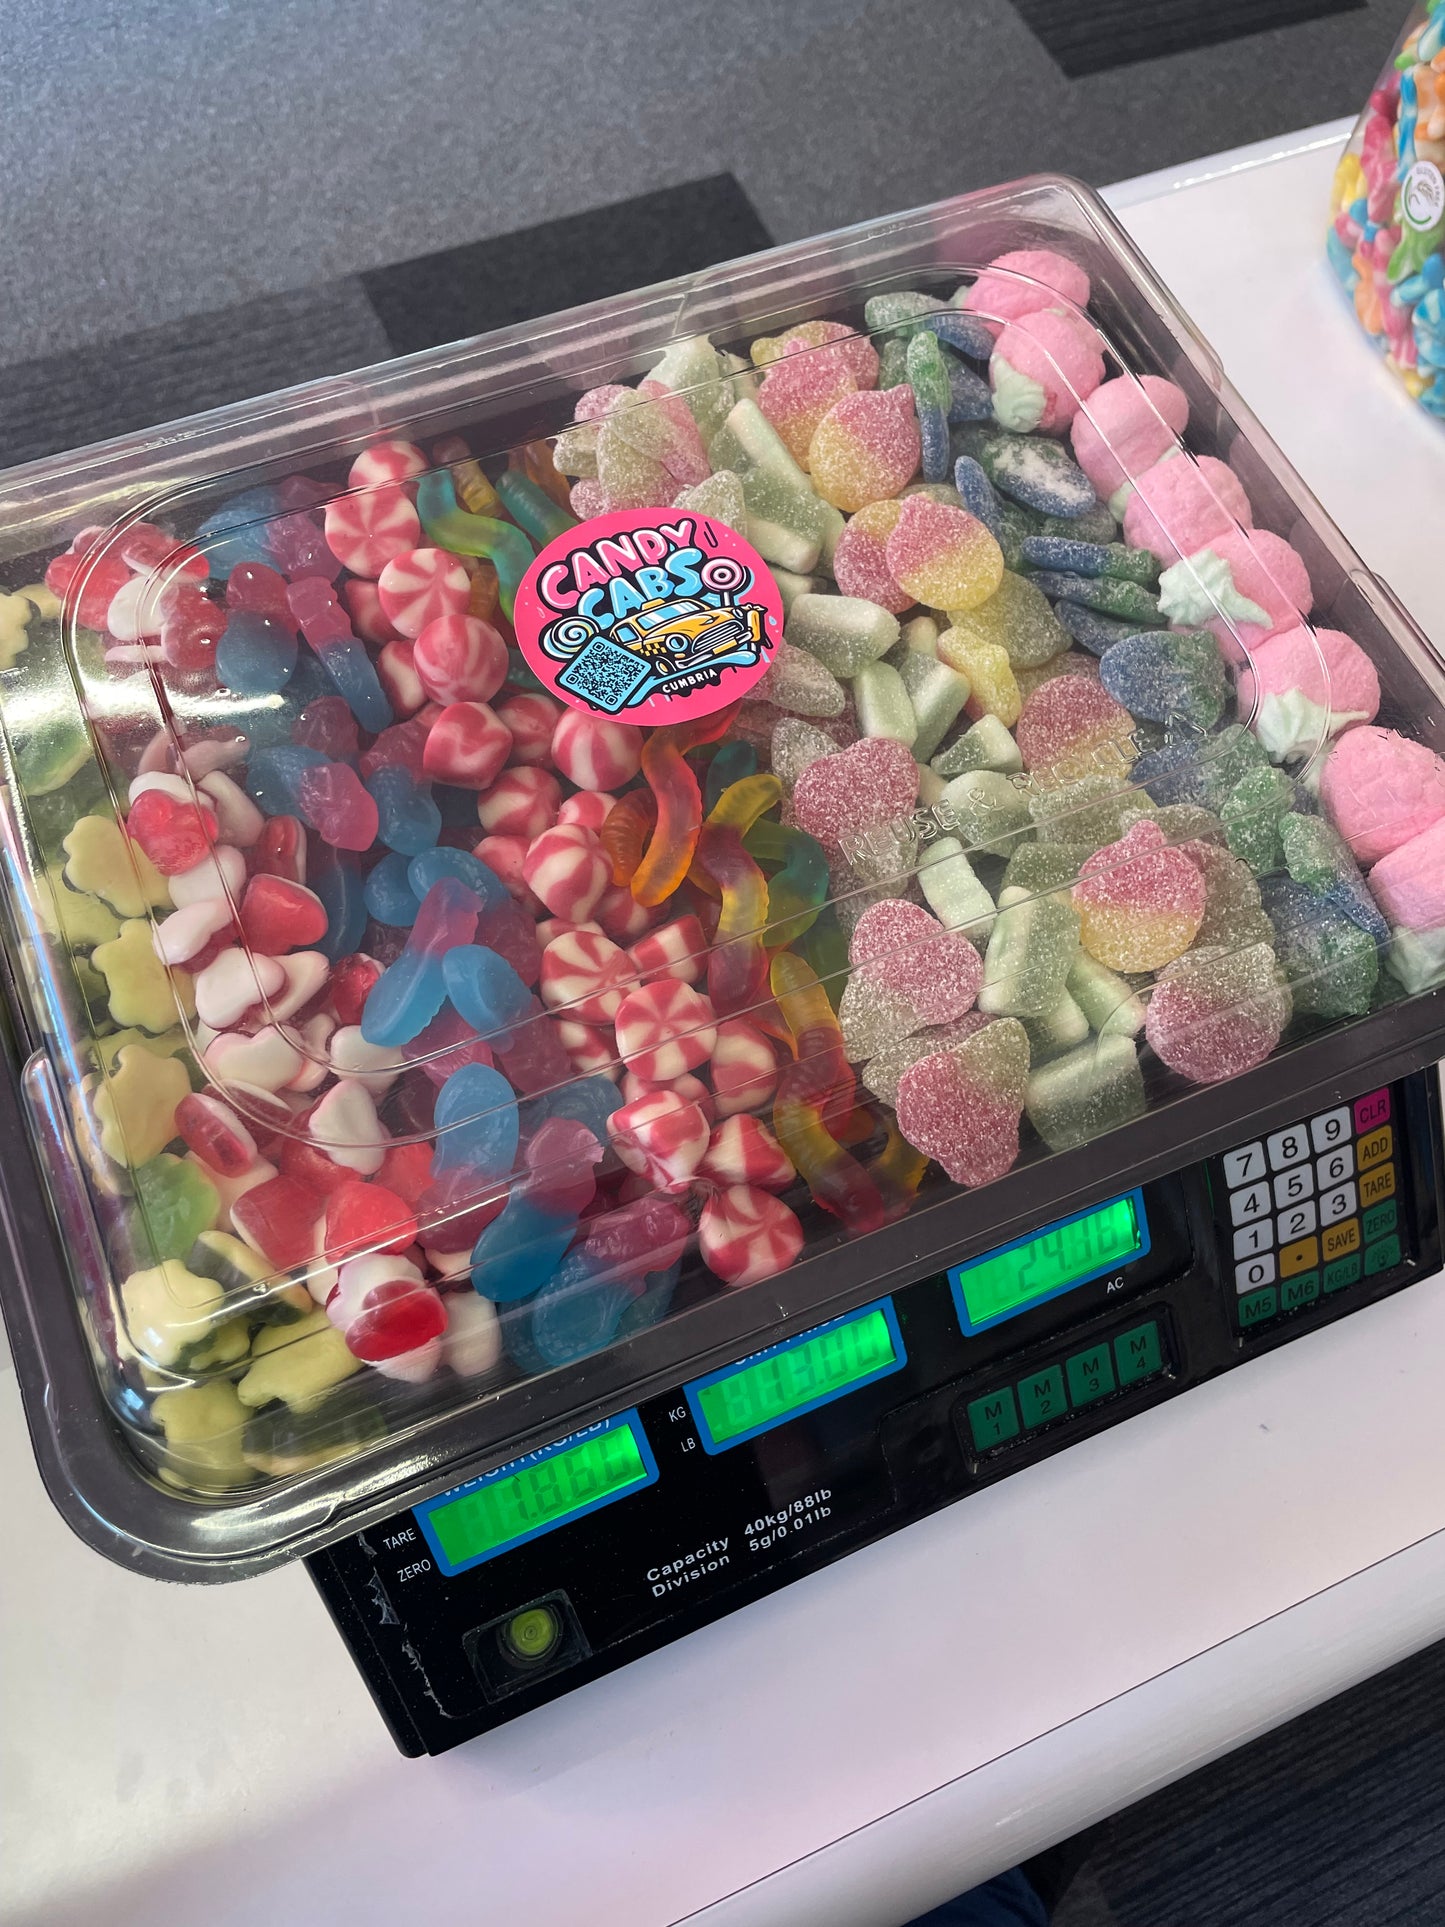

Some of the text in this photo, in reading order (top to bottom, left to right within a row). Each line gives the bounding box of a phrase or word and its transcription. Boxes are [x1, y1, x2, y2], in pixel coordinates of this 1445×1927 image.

[540, 519, 694, 610] CANDY
[577, 548, 704, 630] CABS
[662, 668, 718, 694] CUMBRIA
[838, 798, 960, 865] REUSE
[966, 787, 997, 816] &
[1359, 1099, 1387, 1123] CLR
[1325, 1119, 1340, 1142] 9
[1281, 1136, 1298, 1159] 8
[1363, 1137, 1388, 1161] ADD
[1236, 1152, 1253, 1177] 7
[1329, 1157, 1344, 1178] 6
[1288, 1176, 1303, 1197] 5
[1364, 1173, 1392, 1198] TARE
[1243, 1193, 1260, 1213] 4
[1332, 1194, 1346, 1215] 3
[1290, 1213, 1306, 1235] 2
[1366, 1211, 1395, 1235] ZERO
[1248, 1230, 1258, 1248] 1
[1327, 1228, 1356, 1252] SAVE
[1248, 1265, 1264, 1284] 0
[1327, 1262, 1358, 1284] KG/LB
[1106, 1276, 1124, 1294] AC
[1288, 1280, 1314, 1303] M6
[1245, 1295, 1272, 1319] M5
[1130, 1335, 1147, 1354] M
[1083, 1358, 1099, 1376] M
[1136, 1356, 1146, 1369] 4
[1034, 1379, 1050, 1398] M
[1089, 1378, 1099, 1392] 3
[668, 1406, 686, 1423] KG
[984, 1402, 1002, 1420] M
[1041, 1400, 1052, 1415] 2
[993, 1423, 1000, 1435] 1
[680, 1437, 696, 1453] LB
[382, 1527, 417, 1550] TARE
[646, 1488, 832, 1581] Capacity 40kg/88lb
[652, 1505, 832, 1598] Division 5g/0.01lb
[396, 1559, 431, 1583] ZERO
